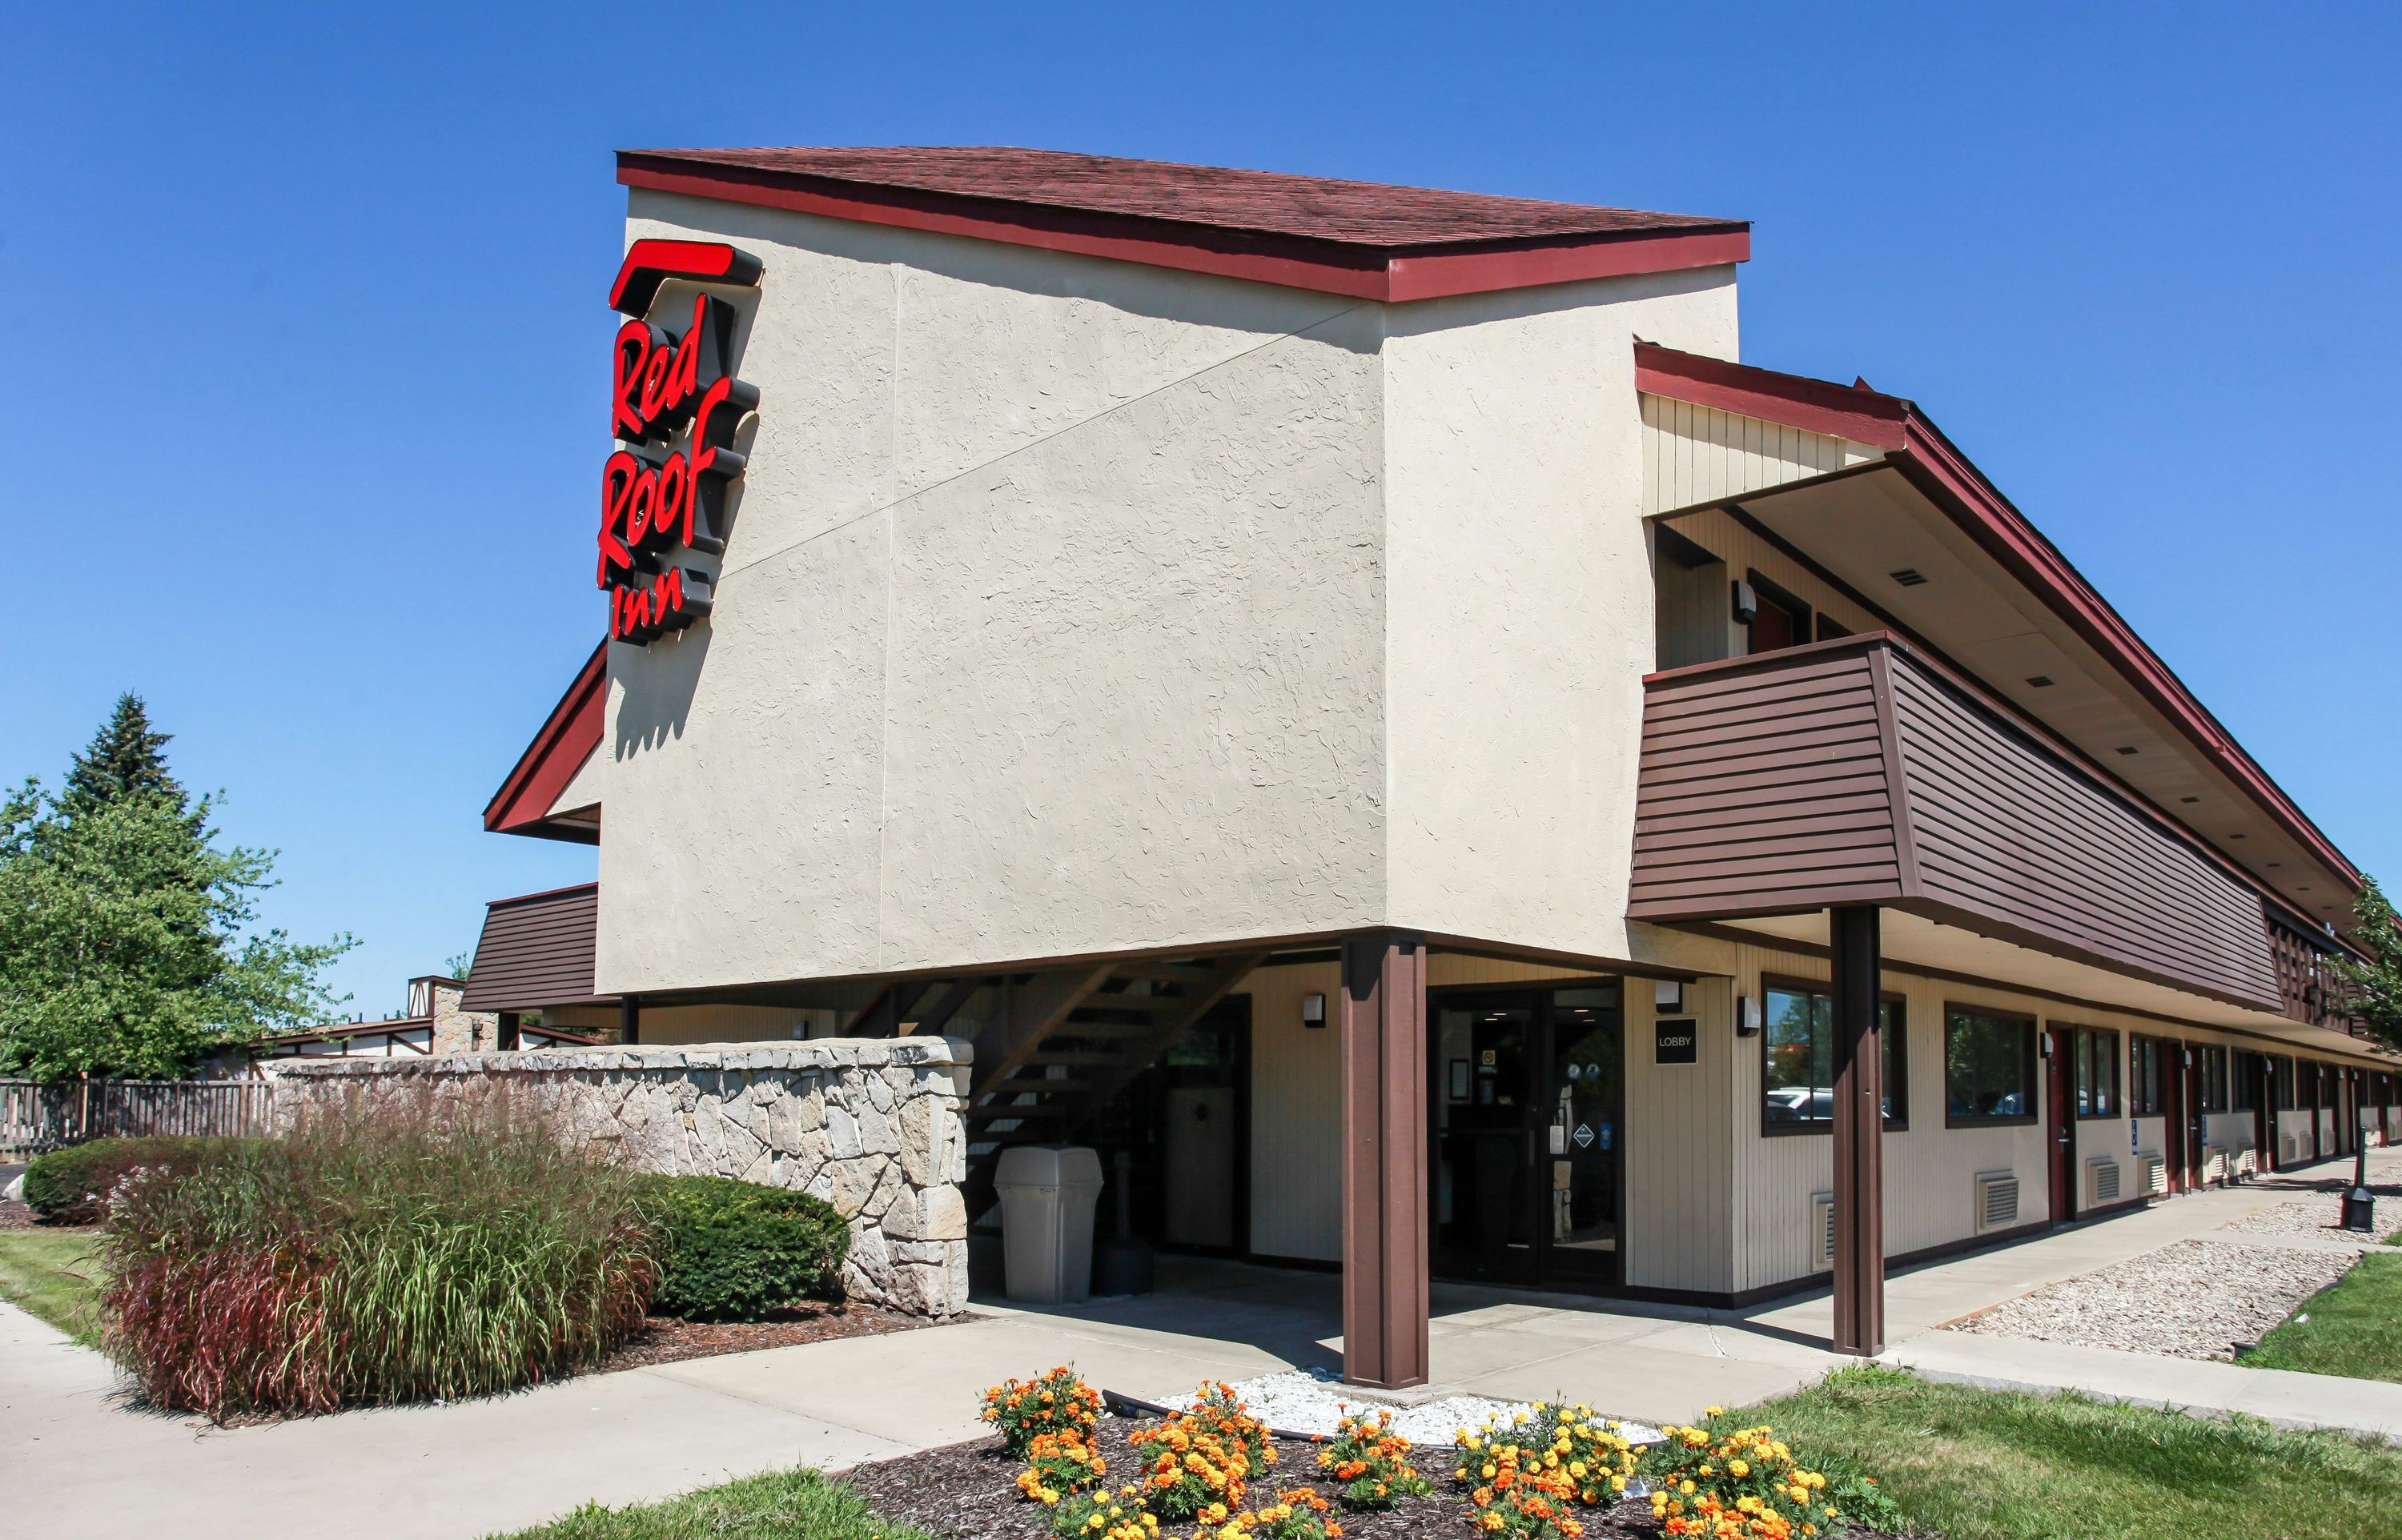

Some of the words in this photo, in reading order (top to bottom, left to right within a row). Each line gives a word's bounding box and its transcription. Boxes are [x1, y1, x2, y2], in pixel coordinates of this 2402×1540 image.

[612, 292, 708, 438] Red
[597, 375, 730, 589] Roof
[1659, 1037, 1692, 1047] LOBBY
